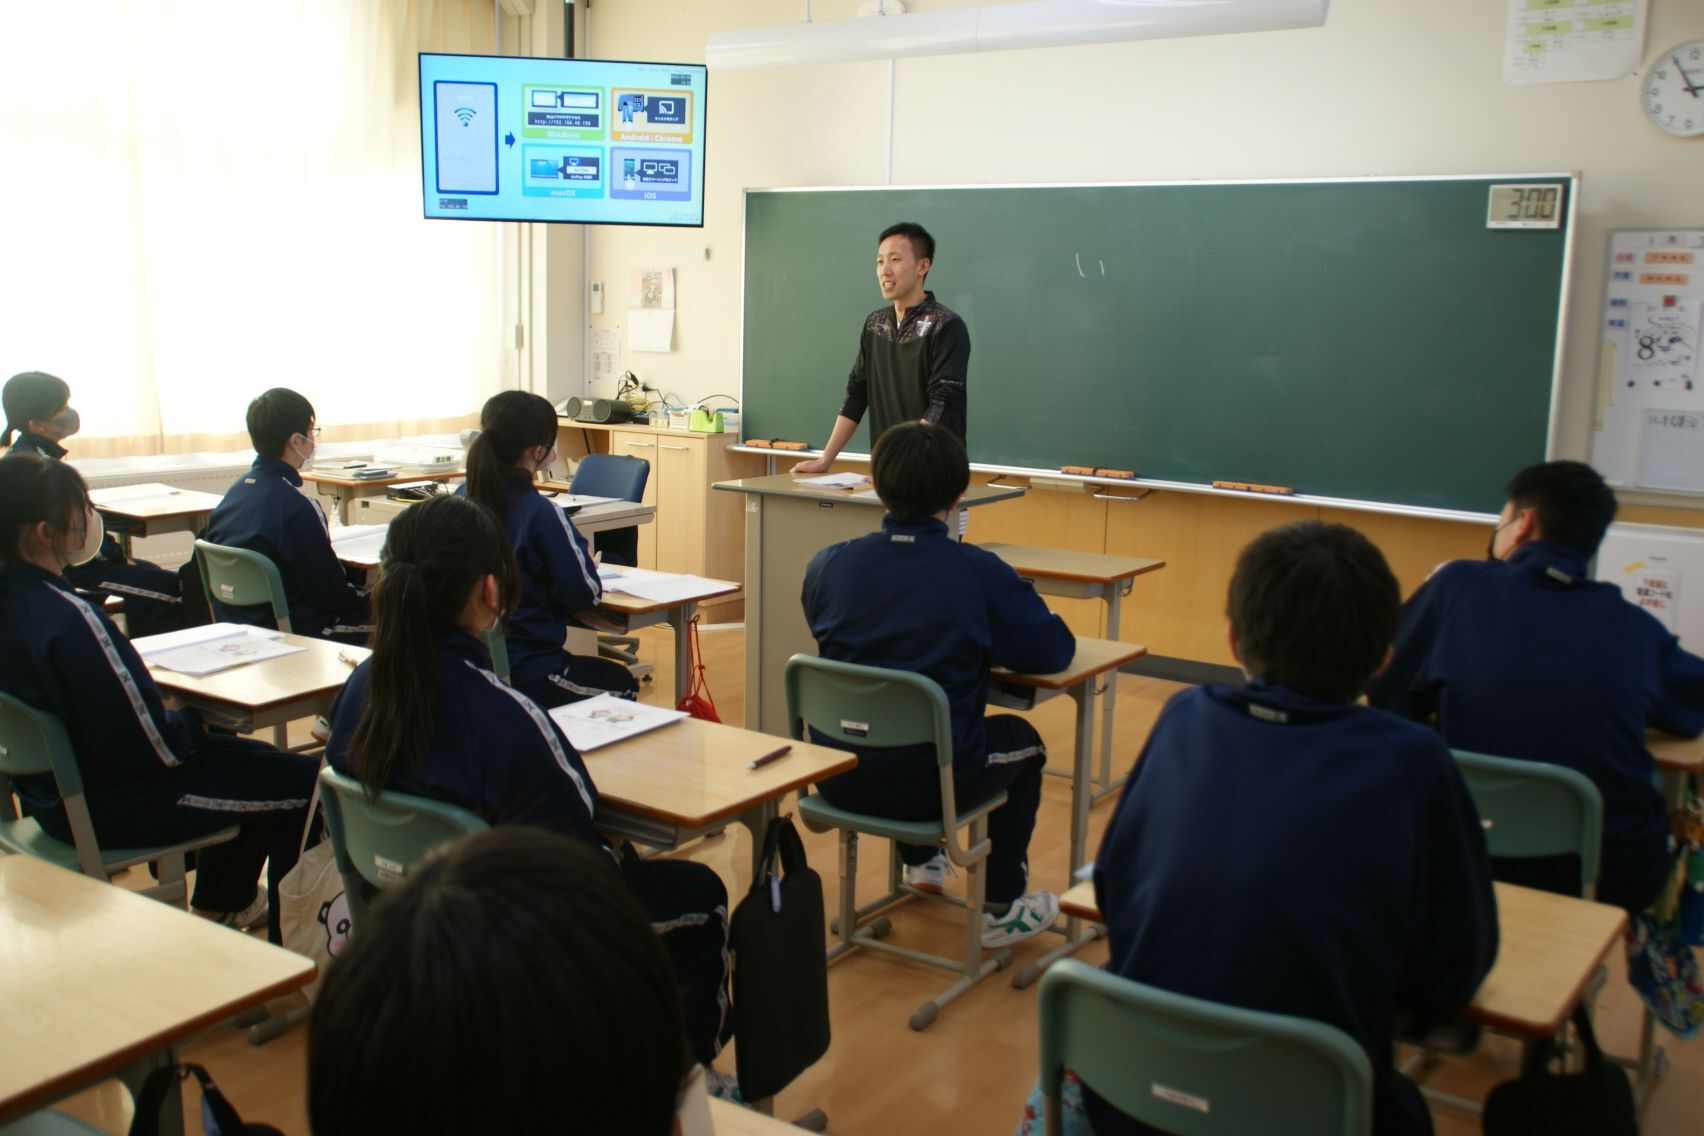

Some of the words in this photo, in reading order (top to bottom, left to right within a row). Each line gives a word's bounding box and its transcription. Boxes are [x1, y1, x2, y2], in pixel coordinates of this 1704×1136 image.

[546, 130, 581, 139] Windows
[620, 133, 650, 142] Android
[655, 134, 684, 143] Chrome
[550, 189, 576, 197] macOS
[644, 192, 657, 200] iOS
